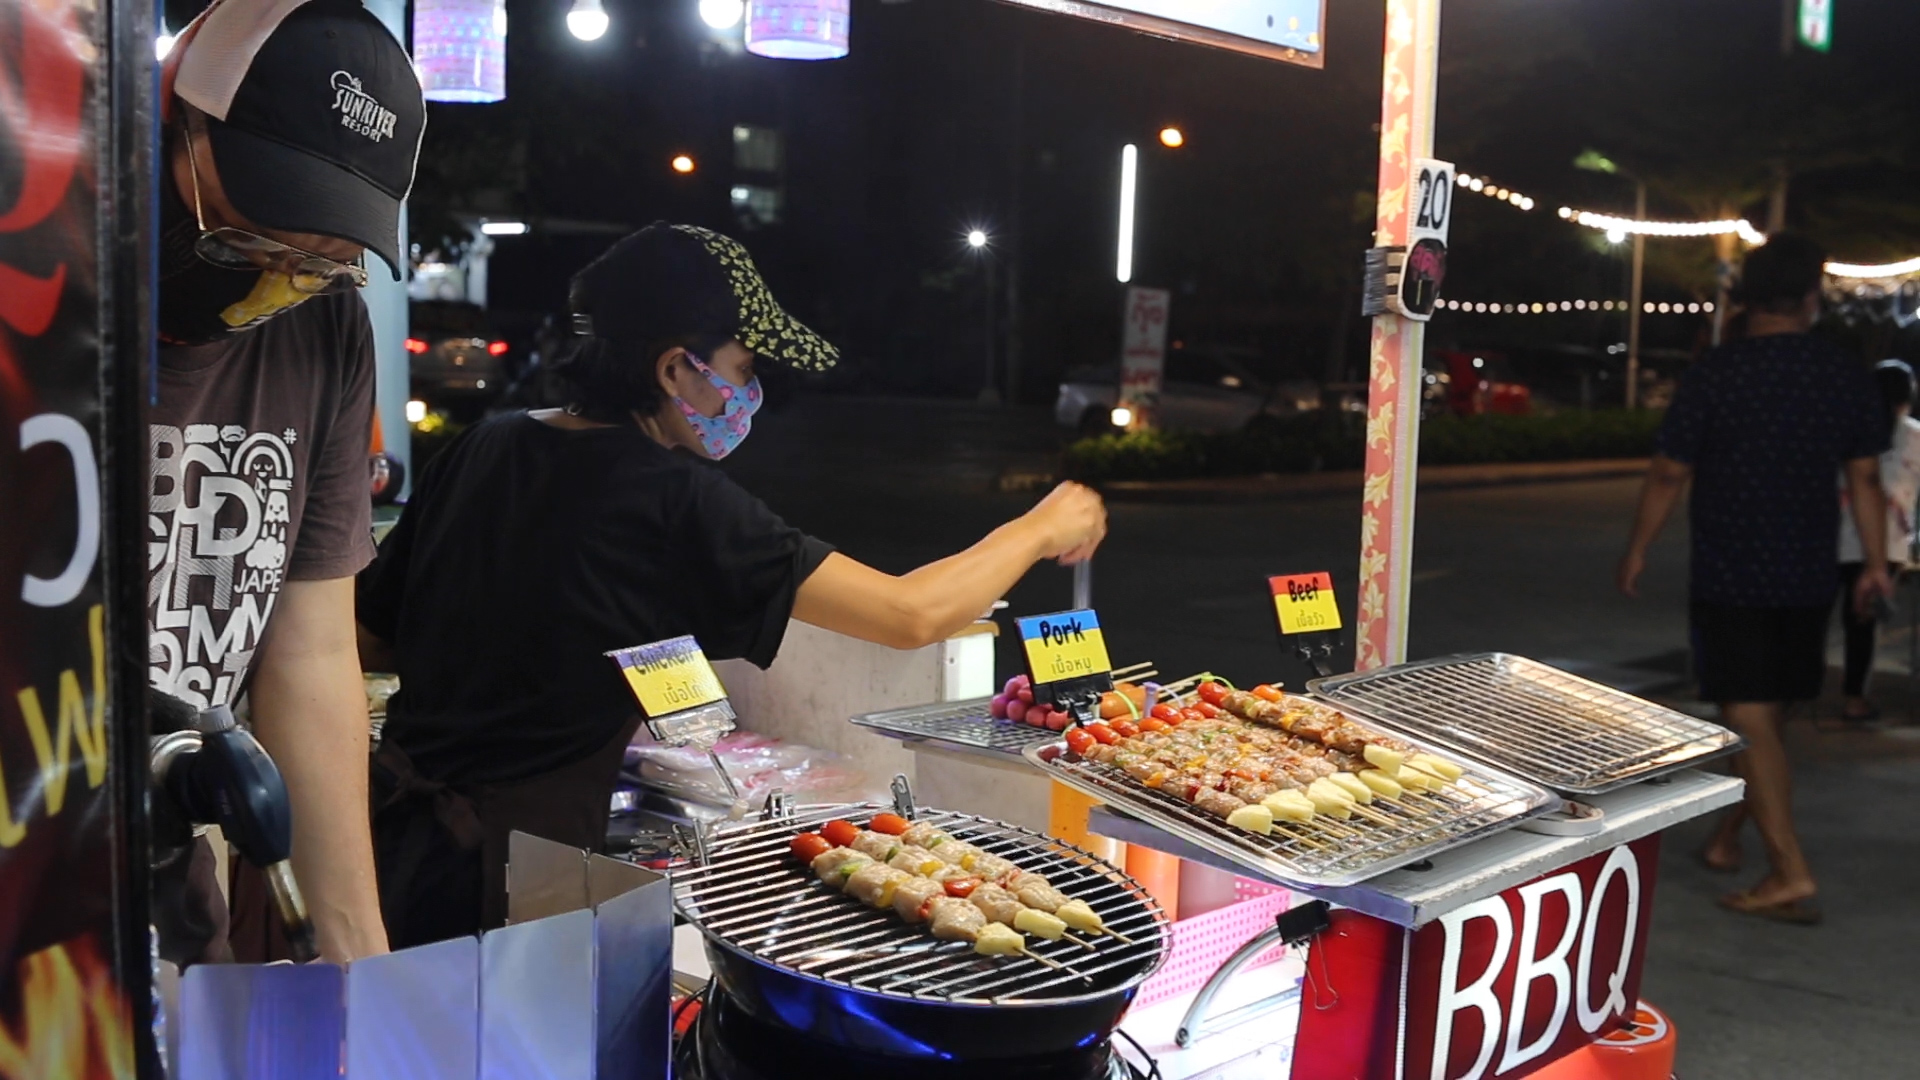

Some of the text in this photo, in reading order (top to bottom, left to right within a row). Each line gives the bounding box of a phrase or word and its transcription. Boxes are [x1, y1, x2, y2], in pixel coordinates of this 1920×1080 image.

[331, 89, 397, 138] SUNRIVER
[341, 114, 383, 142] RESORT
[1416, 168, 1448, 230] 20
[234, 569, 283, 593] JAPE
[1287, 577, 1319, 602] Beef
[1039, 617, 1086, 648] Pork
[1430, 844, 1640, 1080] BBQ
